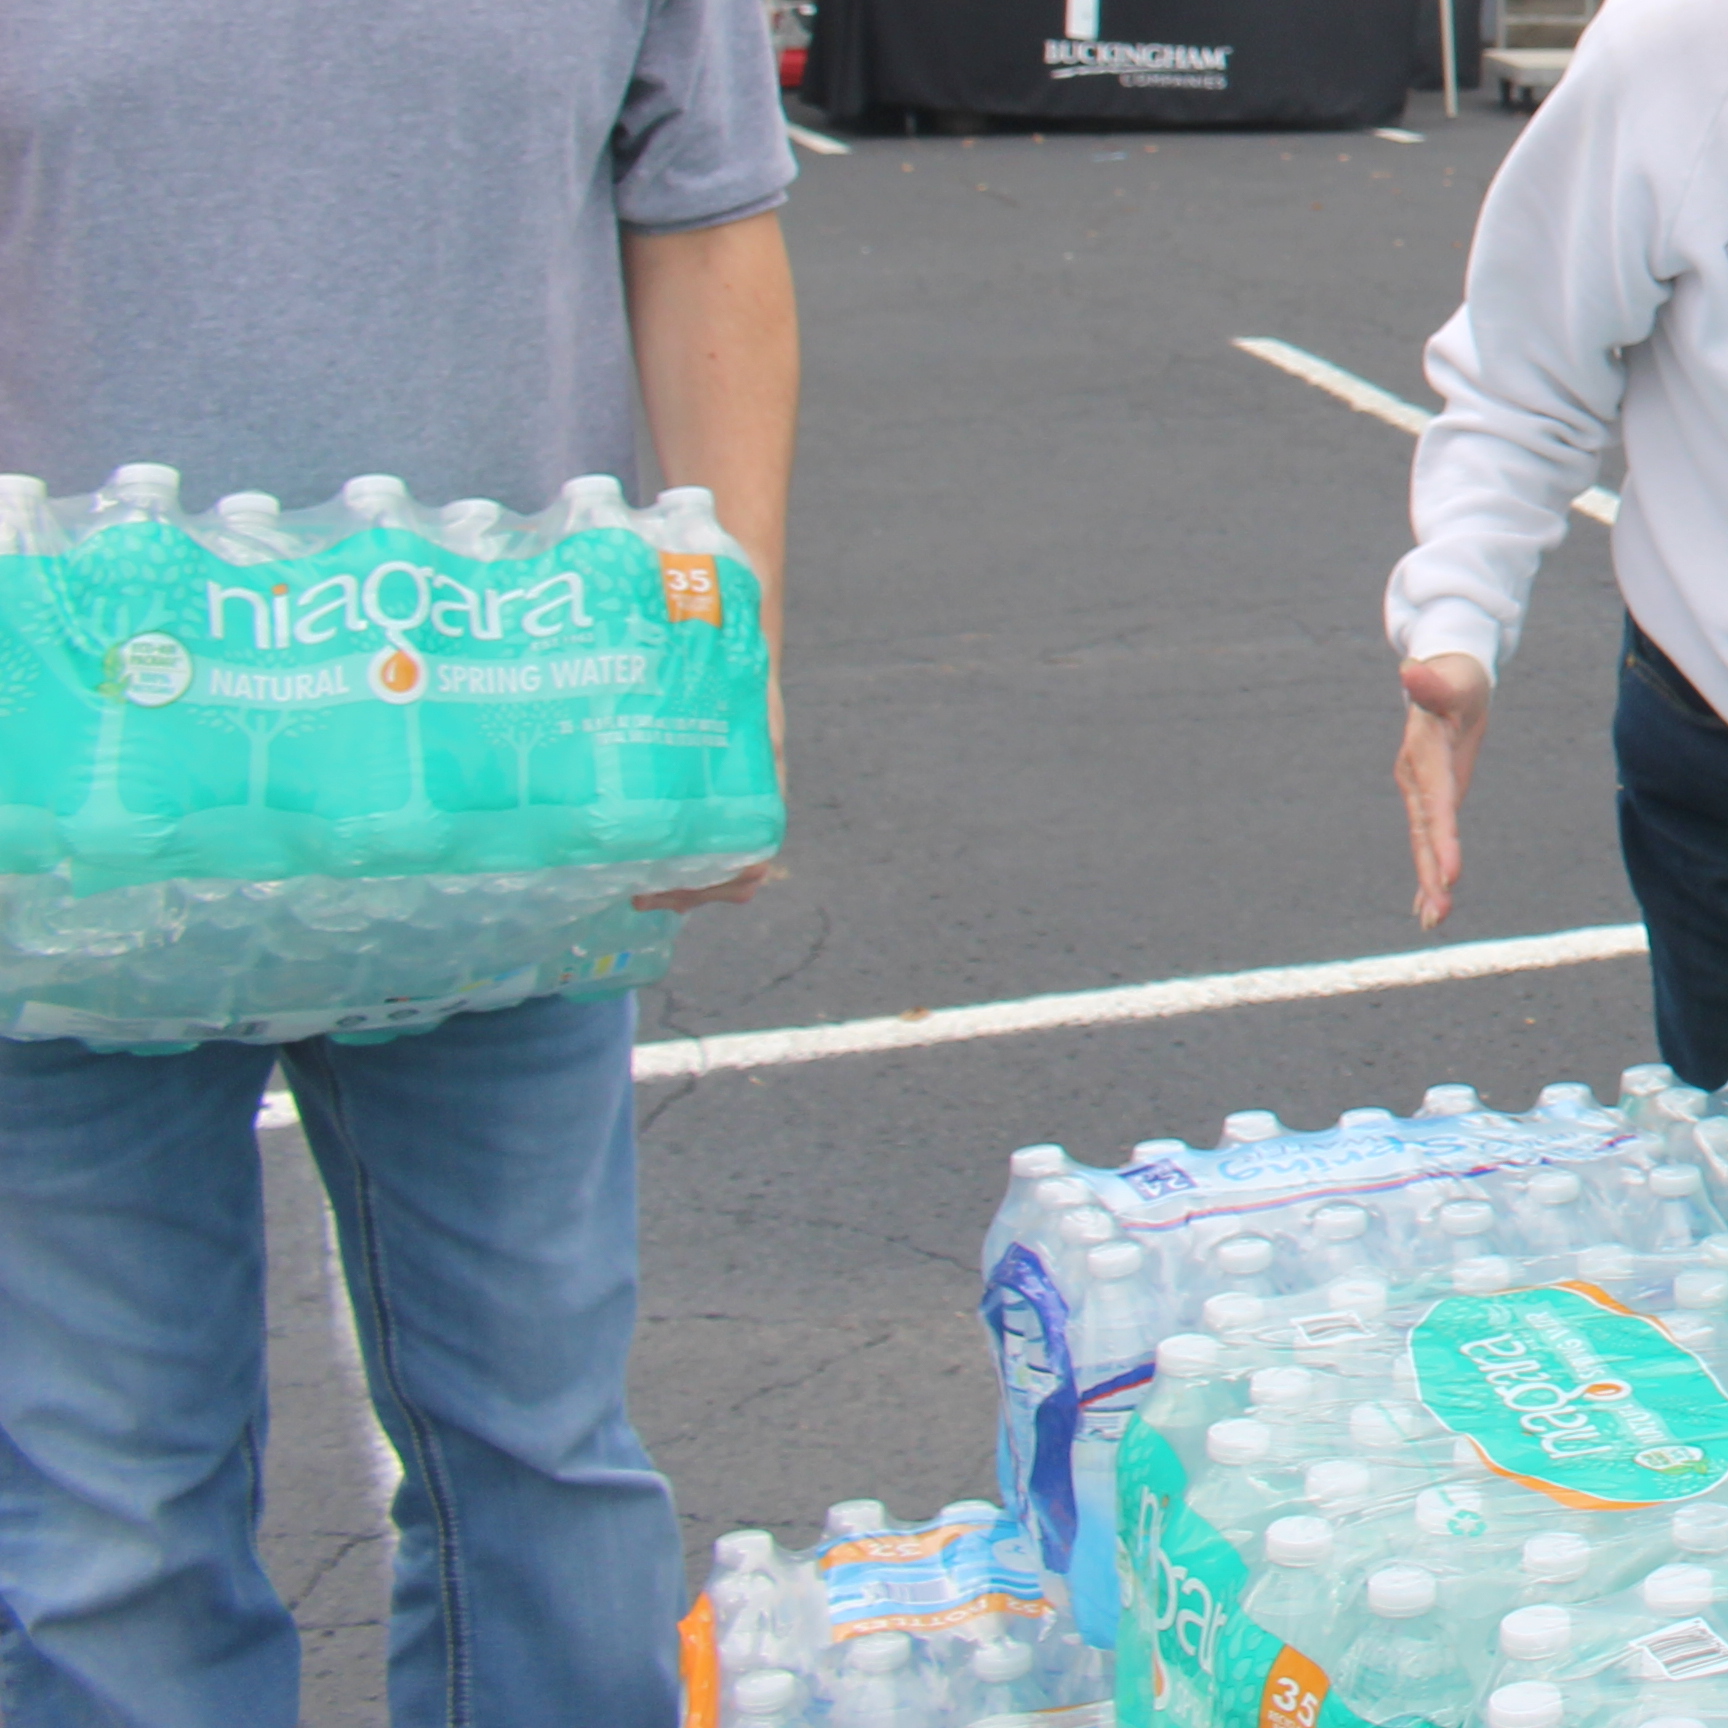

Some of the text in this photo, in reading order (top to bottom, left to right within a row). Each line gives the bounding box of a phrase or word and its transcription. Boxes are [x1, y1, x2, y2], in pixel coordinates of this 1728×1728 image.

[1043, 39, 1227, 71] BUCKINGHAM
[666, 568, 713, 593] 35
[207, 560, 594, 652] niagara
[209, 664, 350, 703] NATURAL
[437, 664, 542, 695] SPRING
[549, 654, 647, 690] WATER
[1272, 1677, 1318, 1723] 35
